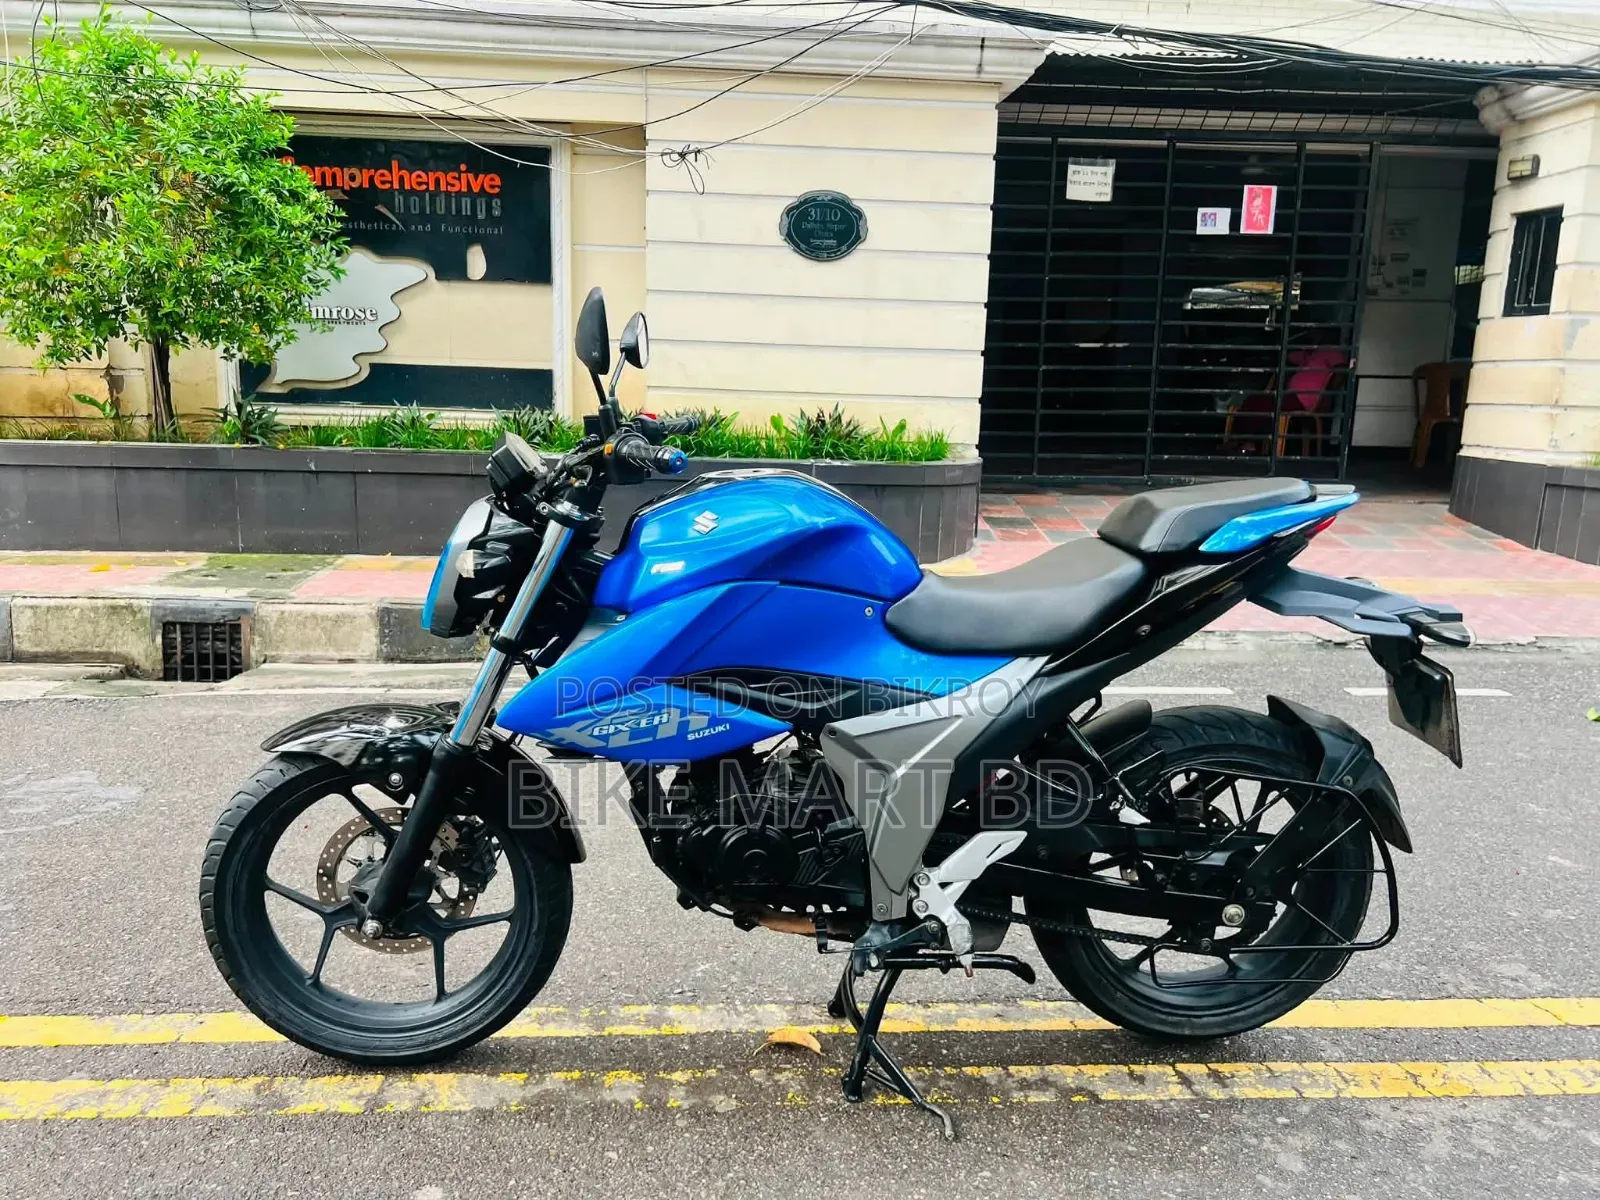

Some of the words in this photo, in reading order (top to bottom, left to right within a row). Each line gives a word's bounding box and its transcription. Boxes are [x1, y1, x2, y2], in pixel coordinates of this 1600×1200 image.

[395, 190, 502, 220] holdings
[807, 207, 841, 221] 31/10
[410, 223, 431, 232] and
[441, 223, 503, 235] Functional
[592, 712, 671, 736] GIXXER
[687, 723, 730, 741] SUZUKI
